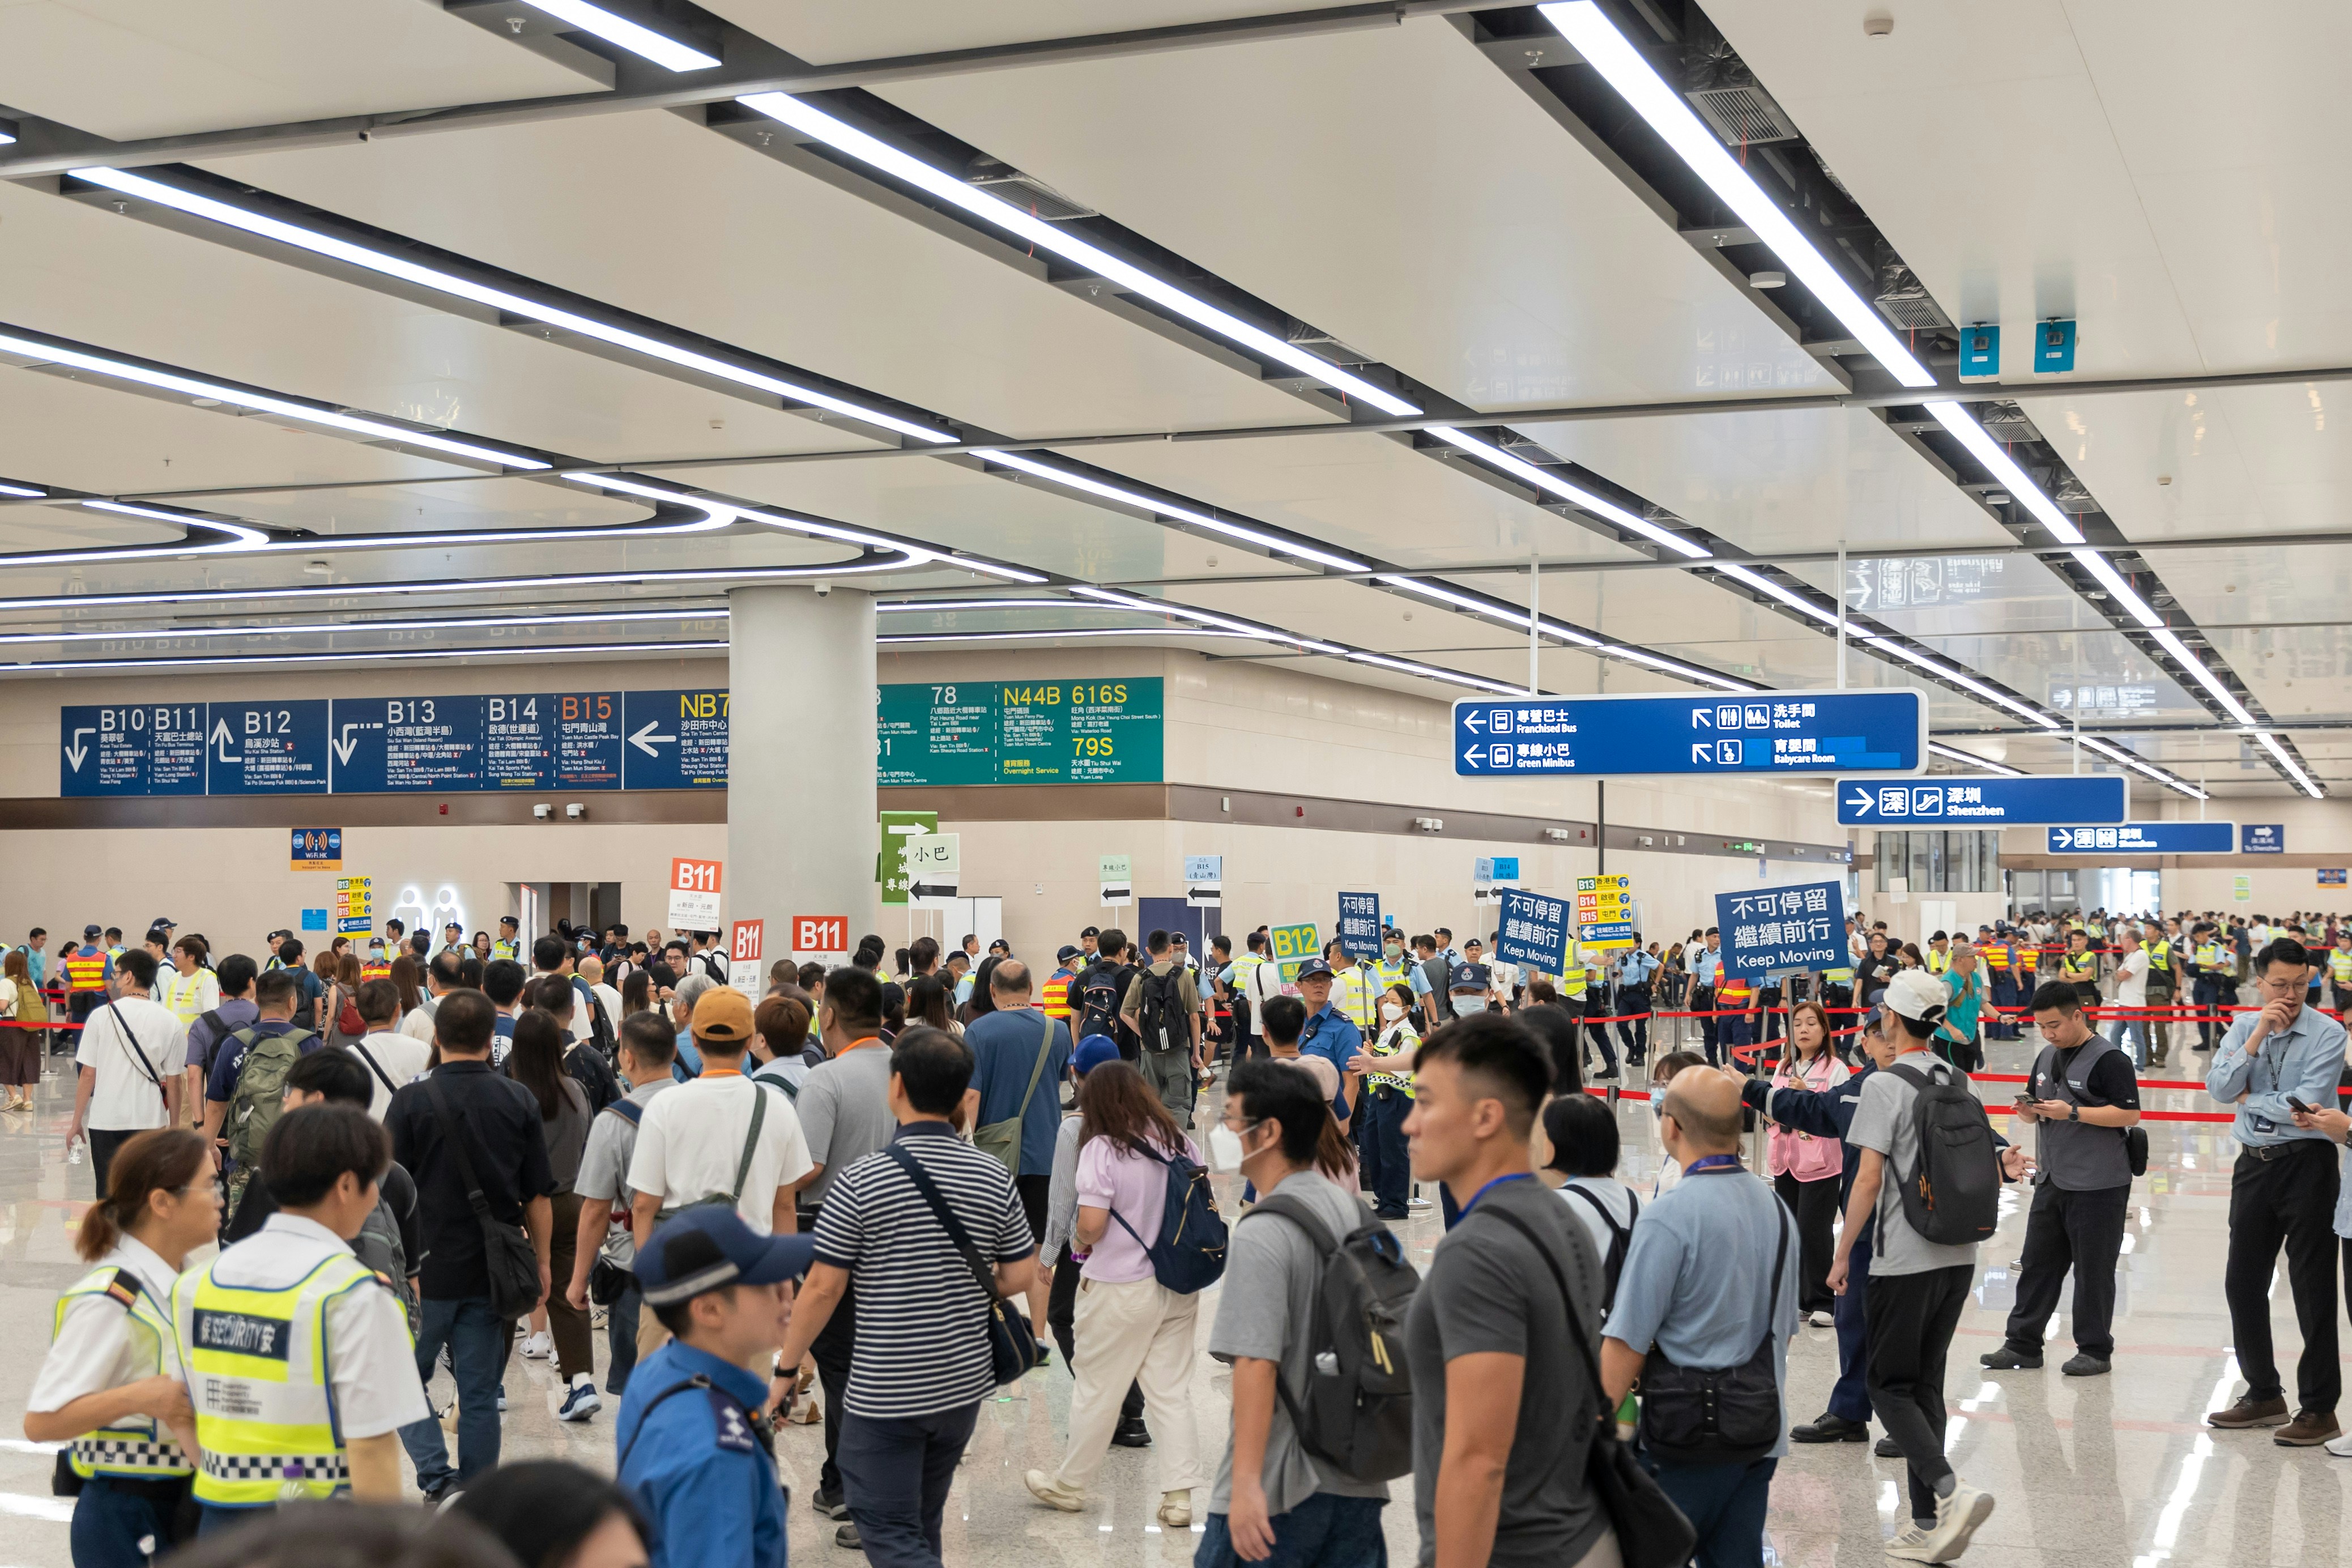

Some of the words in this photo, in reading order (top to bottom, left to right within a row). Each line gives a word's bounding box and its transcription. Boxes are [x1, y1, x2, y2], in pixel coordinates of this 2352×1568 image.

[931, 686, 957, 704] 78
[1004, 687, 1060, 705] N44B
[1072, 685, 1127, 704] 616S
[388, 700, 435, 723] B13
[489, 698, 538, 721] B14
[563, 696, 612, 719] B15
[681, 693, 729, 718] NB7
[1774, 704, 1816, 718] 洗手間
[101, 709, 144, 731] B10
[155, 708, 195, 730] B11
[246, 710, 291, 734] B12
[681, 720, 727, 730] 沙田市中心
[1517, 709, 1569, 723] 專營巴士
[1773, 719, 1800, 728] Toilet
[562, 723, 607, 733] 屯門青山灣
[1517, 723, 1561, 733] Franchised
[1561, 723, 1577, 732] Bus
[1072, 738, 1113, 756] 79S
[1517, 743, 1570, 757] 專線小巴
[1774, 739, 1816, 753] 育嬰間
[1517, 759, 1541, 768] Green
[1543, 757, 1575, 767] Minibus
[1774, 755, 1810, 765] Babycare
[1812, 754, 1835, 763] Room
[1947, 787, 1981, 803] 深圳
[1947, 804, 2005, 816] Shenzhen
[914, 847, 949, 862] 小巴
[338, 880, 349, 889] B13
[678, 863, 715, 890] B11
[1578, 879, 1595, 890] B13
[1343, 896, 1374, 914] 不可停留
[1509, 893, 1562, 924] 不可停留
[1579, 896, 1596, 906] B14
[1731, 888, 1827, 920] 不可停留
[338, 907, 349, 916] B15
[1580, 911, 1597, 922] B15
[800, 921, 840, 949] B11
[1344, 918, 1376, 937] 繼續前行
[1506, 918, 1559, 948] 繼續前行
[1734, 918, 1831, 949] 繼續前行
[736, 925, 760, 958] B11
[1274, 927, 1319, 956] B12
[1345, 940, 1357, 951] Keep
[1359, 941, 1378, 953] Moving
[1503, 943, 1524, 958] Keep
[1527, 949, 1557, 967] Moving
[1736, 955, 1775, 968] Keep
[1779, 948, 1834, 964] Moving
[211, 1317, 263, 1349] SECURITY
